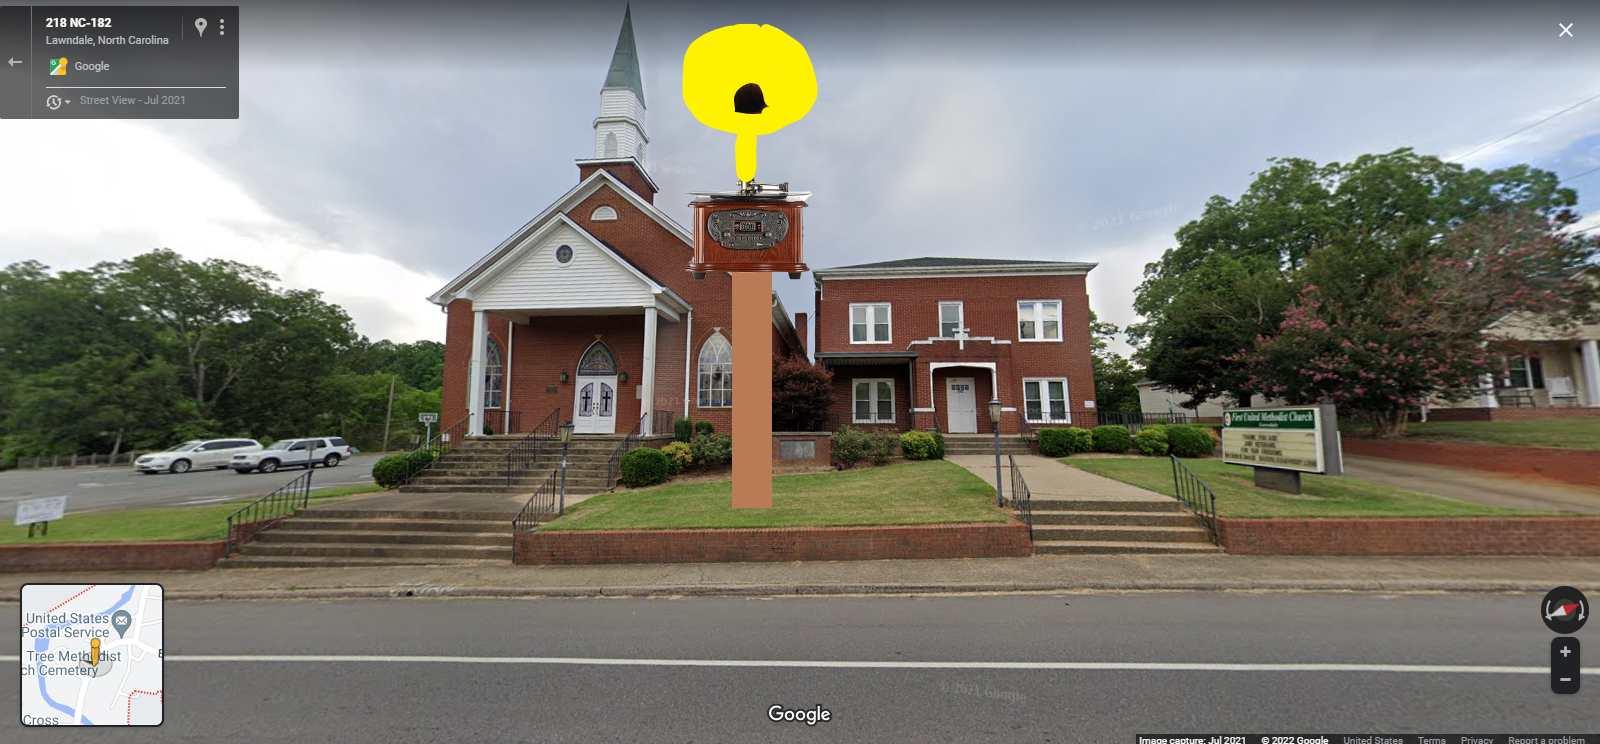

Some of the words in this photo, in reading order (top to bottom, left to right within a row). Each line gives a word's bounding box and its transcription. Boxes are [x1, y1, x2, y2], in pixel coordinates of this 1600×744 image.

[1232, 412, 1244, 422] First
[1244, 412, 1260, 422] United
[1261, 411, 1288, 422] Methodist
[1289, 411, 1313, 422] Church
